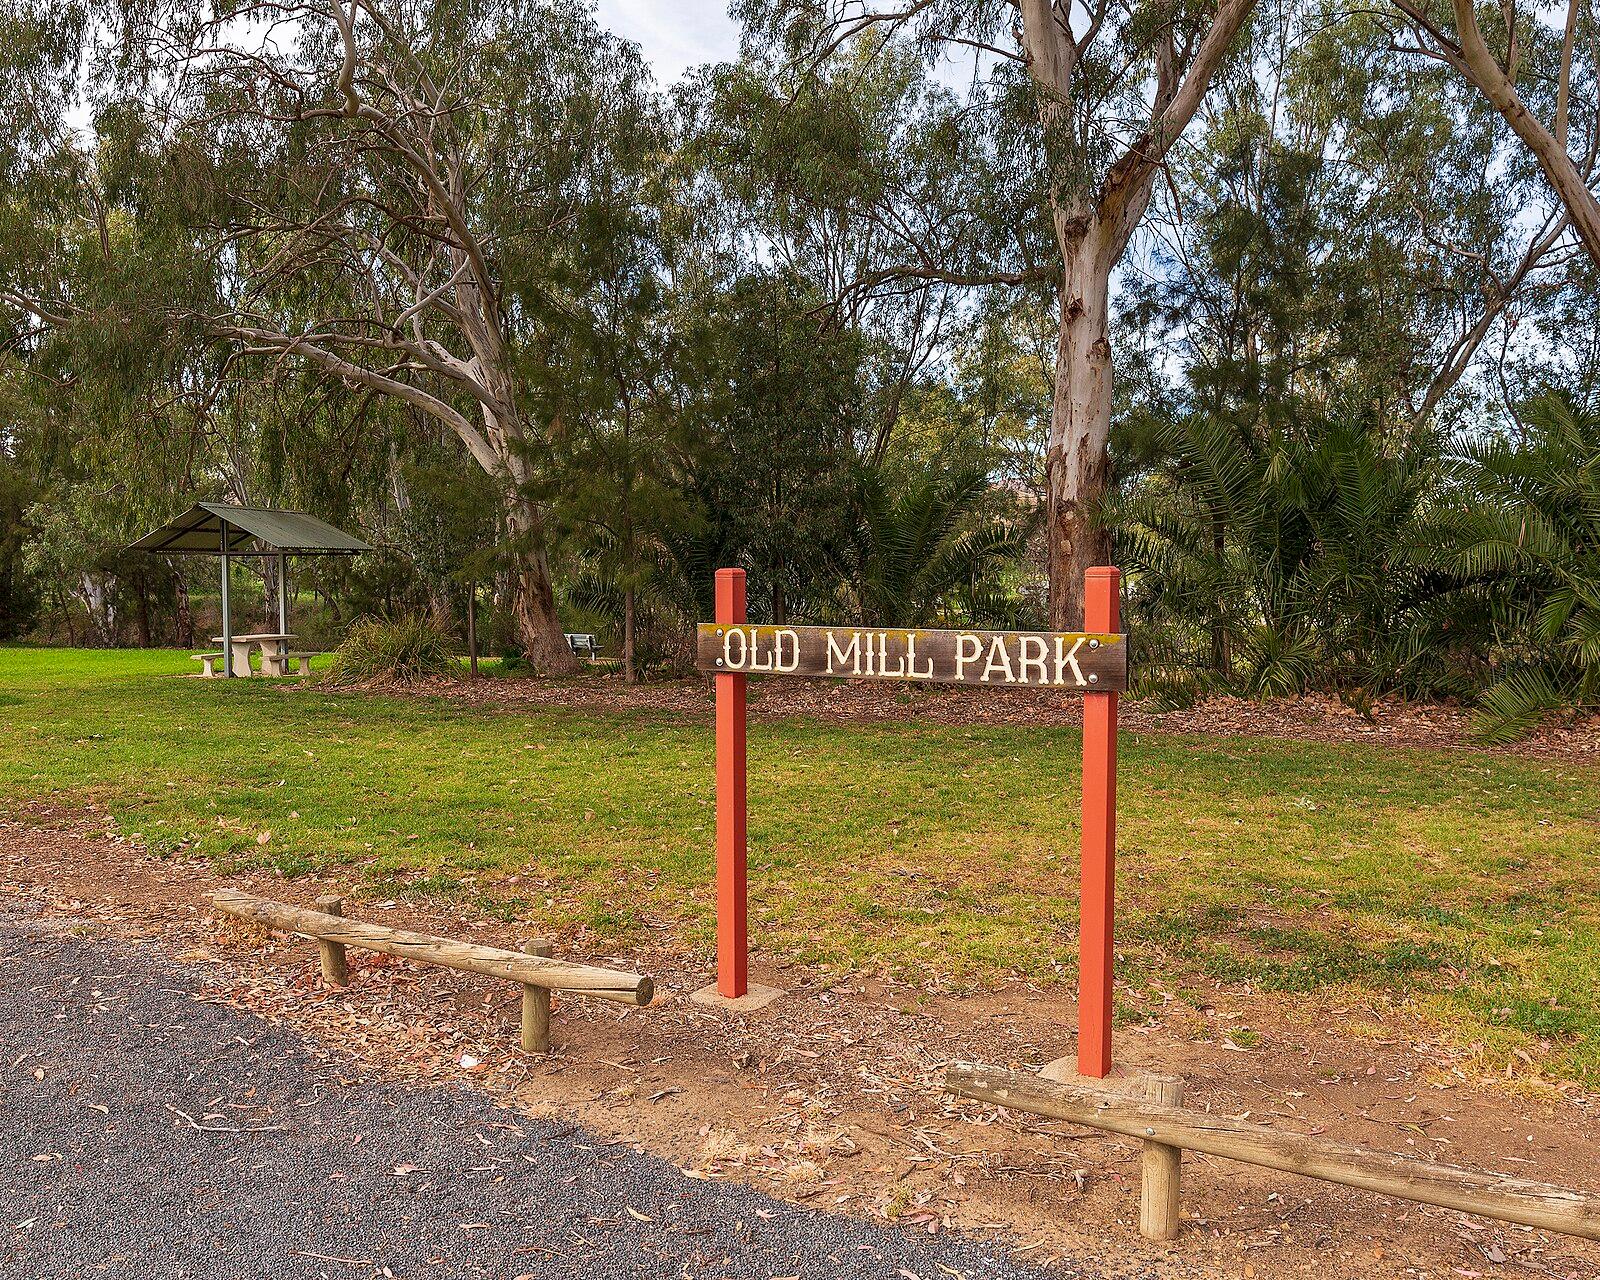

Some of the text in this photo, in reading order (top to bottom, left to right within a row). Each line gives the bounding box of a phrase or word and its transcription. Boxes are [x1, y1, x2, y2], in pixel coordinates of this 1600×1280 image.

[722, 627, 1089, 687] OLD MILL PARK
